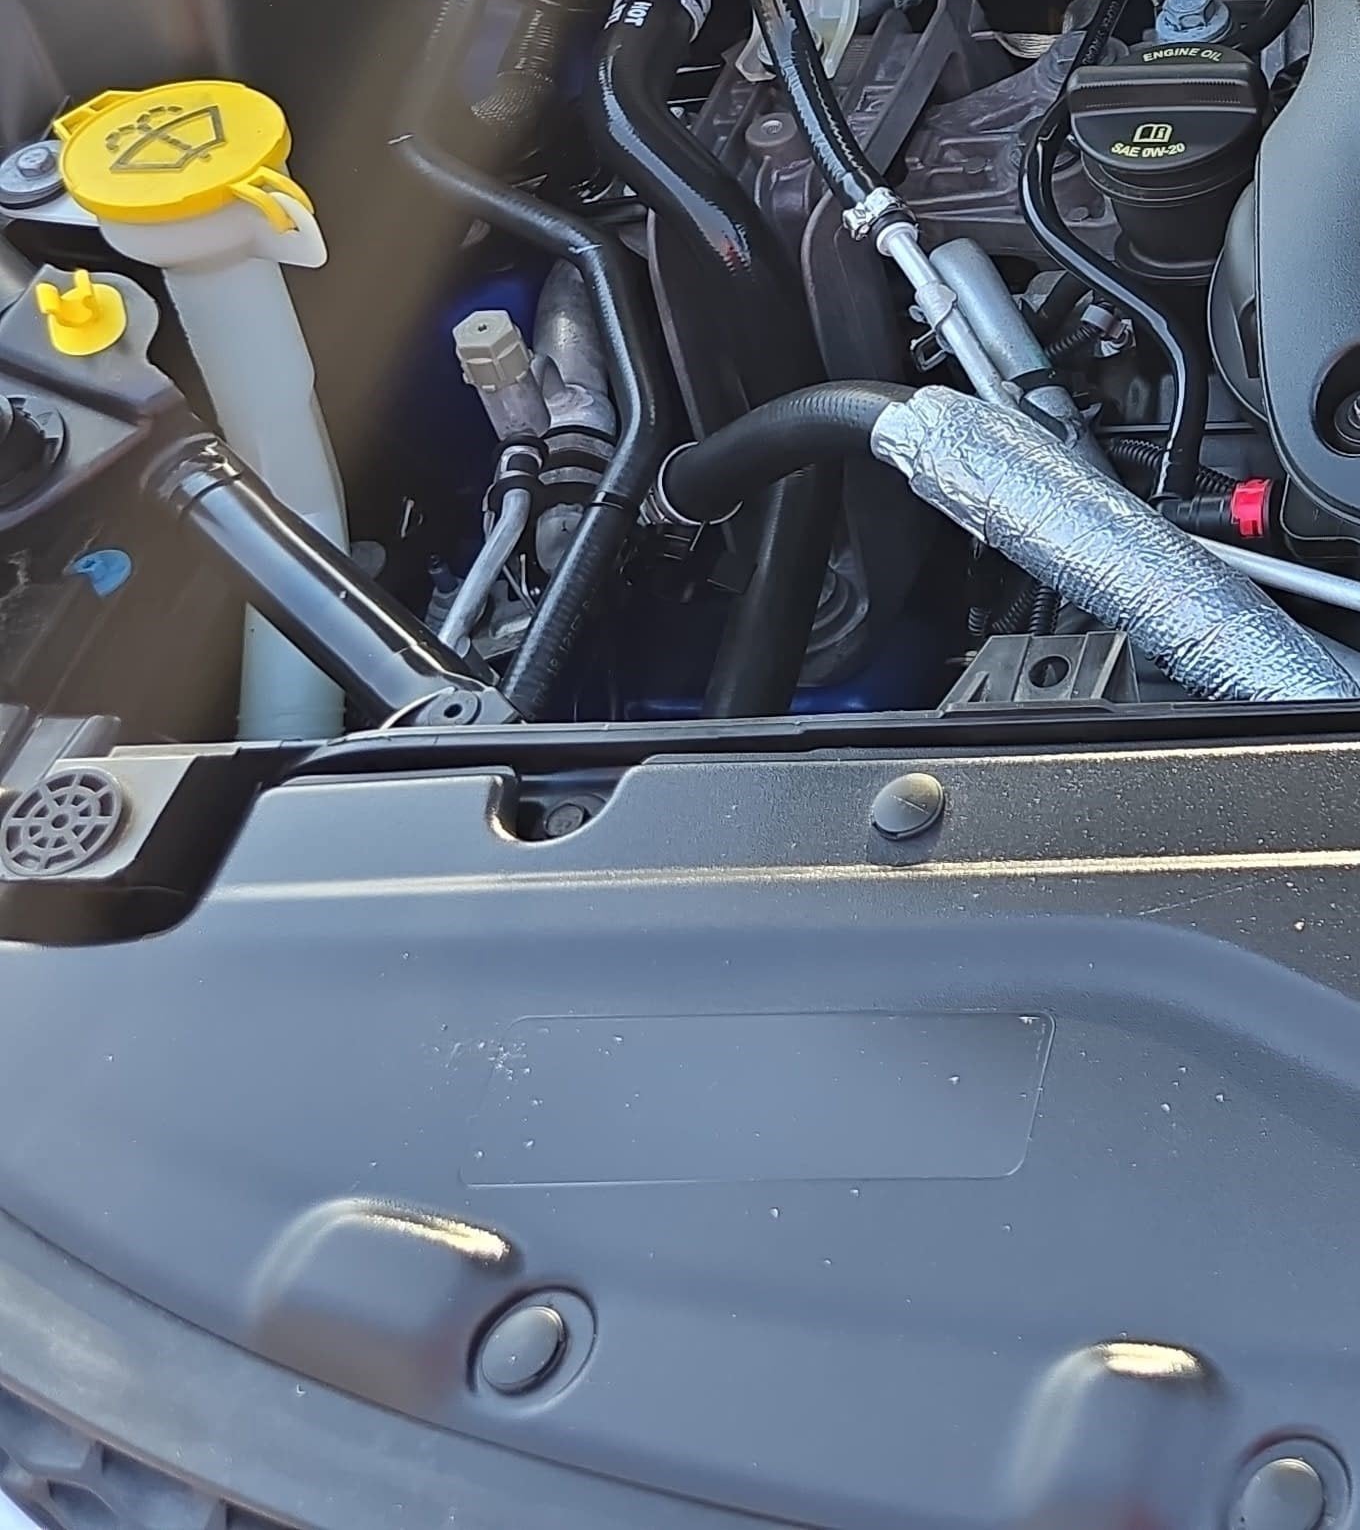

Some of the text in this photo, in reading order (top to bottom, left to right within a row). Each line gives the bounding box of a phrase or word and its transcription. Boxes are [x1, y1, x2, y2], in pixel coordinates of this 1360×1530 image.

[1142, 47, 1224, 62] ENGINE OIL
[1111, 142, 1187, 158] SAE 0W-20
